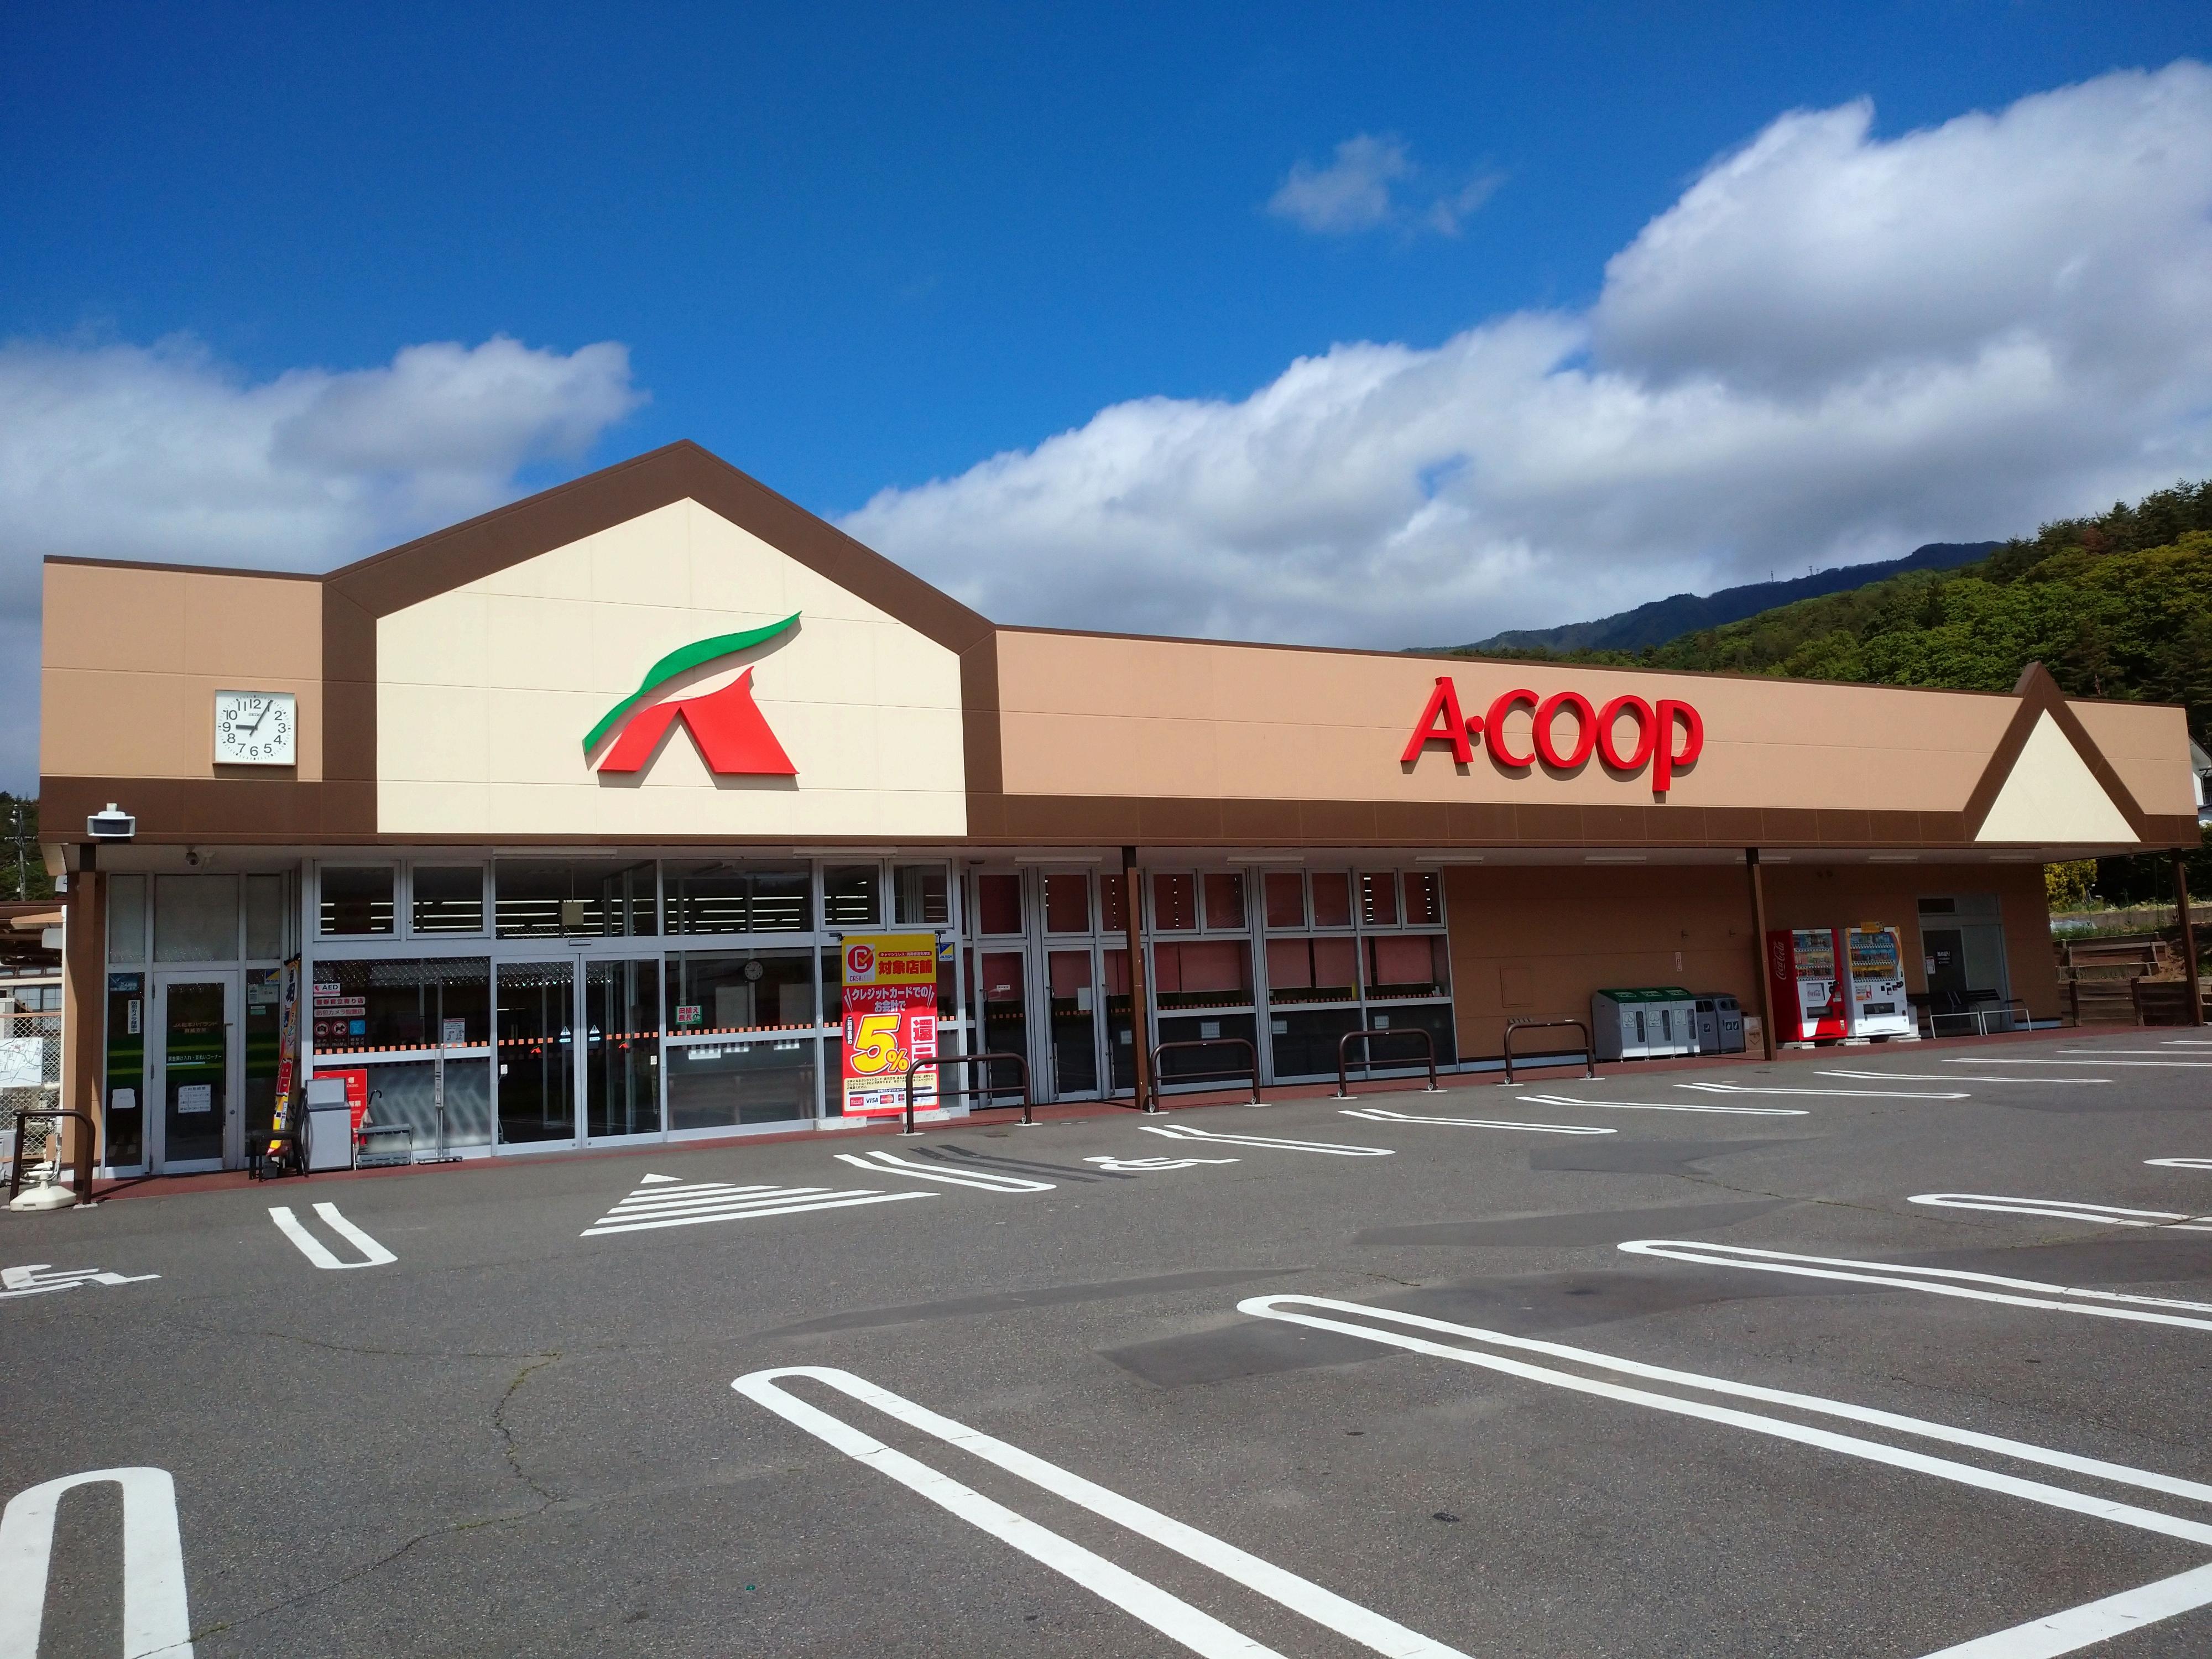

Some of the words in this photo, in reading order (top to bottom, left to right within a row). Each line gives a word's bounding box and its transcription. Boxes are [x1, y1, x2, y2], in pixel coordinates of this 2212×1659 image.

[238, 701, 247, 711] 11
[249, 698, 262, 709] 12
[226, 709, 238, 720] 10
[274, 711, 283, 721] 2
[222, 722, 231, 732] 9
[278, 723, 286, 733] 3
[227, 733, 236, 744] 8
[273, 734, 283, 745] 4
[237, 743, 246, 753] 7
[249, 746, 258, 757] 6
[263, 743, 272, 753] 5
[878, 959, 932, 975] 対象店舗
[852, 986, 928, 1000] クレジットカードでの
[874, 1000, 906, 1012] お会計で
[851, 1013, 910, 1075] 5%
